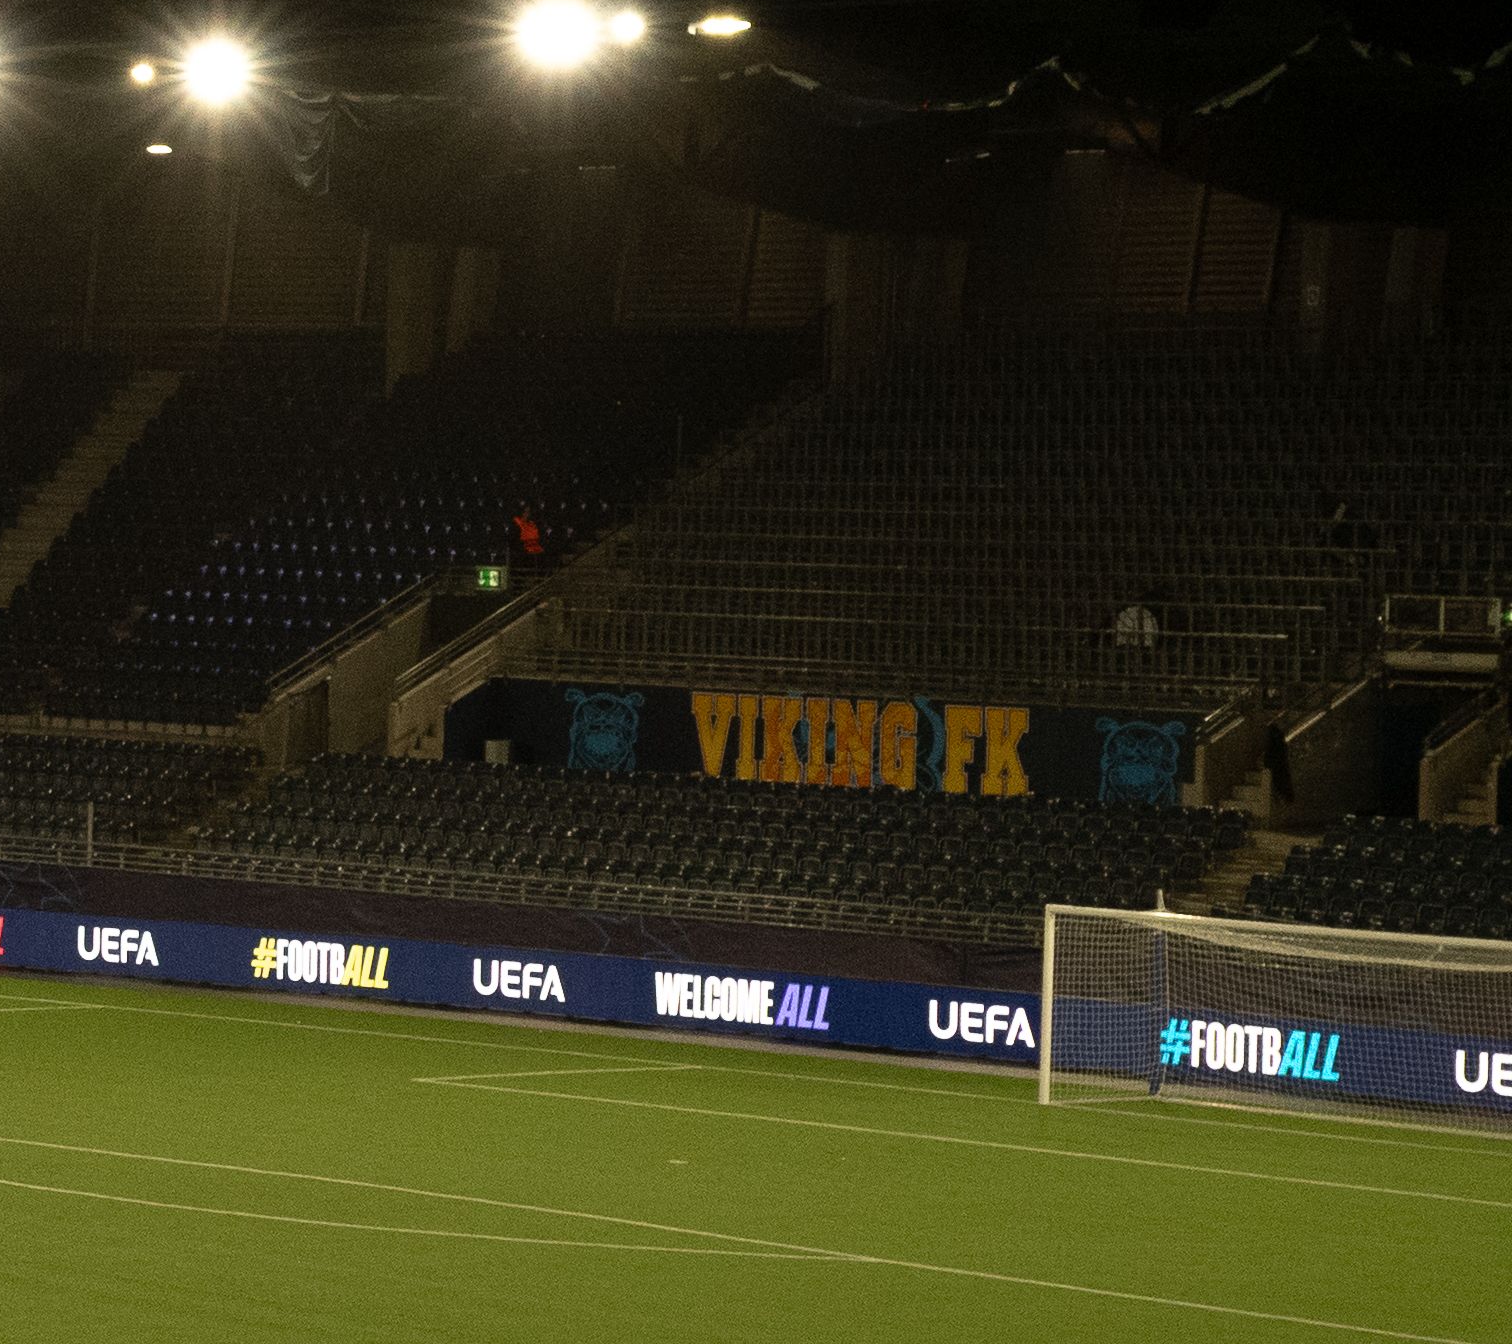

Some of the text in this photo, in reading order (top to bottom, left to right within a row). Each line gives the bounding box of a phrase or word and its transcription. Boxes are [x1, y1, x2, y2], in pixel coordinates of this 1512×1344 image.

[692, 693, 1030, 796] VIKING FK
[78, 926, 161, 968] UEFA
[251, 938, 390, 990] #FOOTBALL
[473, 959, 567, 1004] UEFA
[656, 973, 831, 1032] WELCOME ALL
[929, 1000, 1037, 1049] UEFA
[1160, 1019, 1341, 1082] #FOOTBALL
